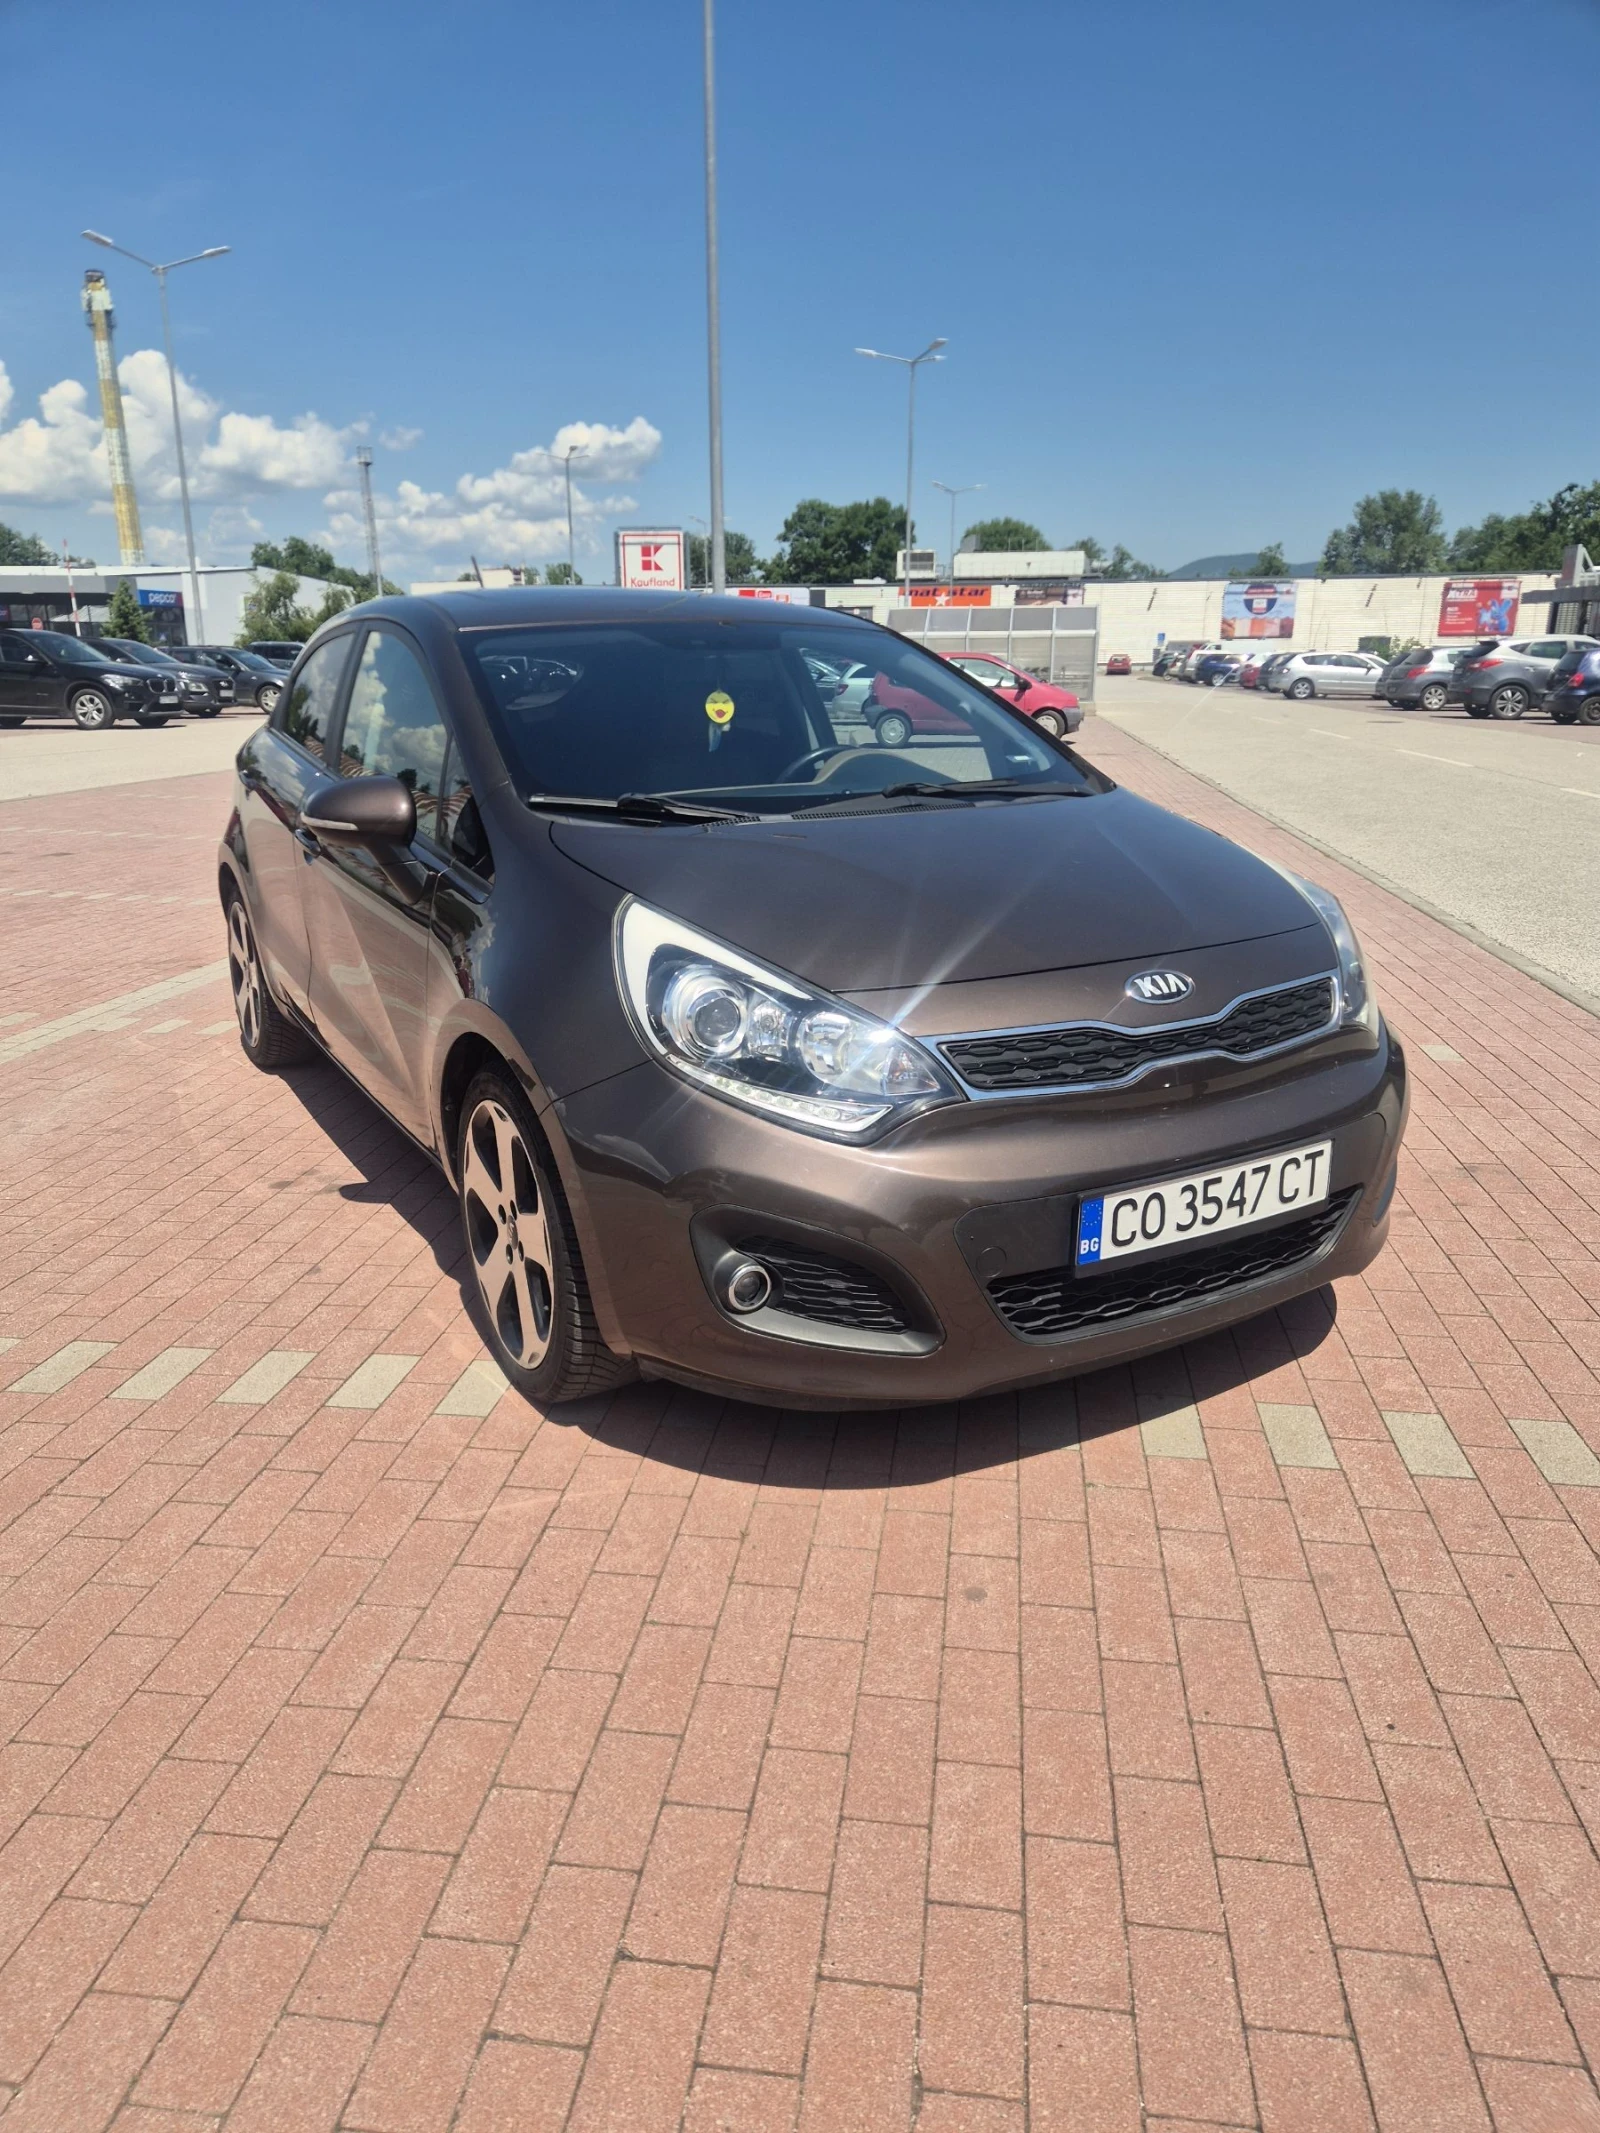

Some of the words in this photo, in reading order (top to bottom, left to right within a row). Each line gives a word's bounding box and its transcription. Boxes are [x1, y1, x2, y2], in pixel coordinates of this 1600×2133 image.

[631, 577, 675, 587] Kaufland
[948, 588, 988, 597] star
[1134, 974, 1187, 998] KIA
[1111, 1192, 1166, 1247] CO
[1176, 1164, 1271, 1231] 3547
[1278, 1149, 1324, 1204] CT
[1080, 1238, 1099, 1254] BG
